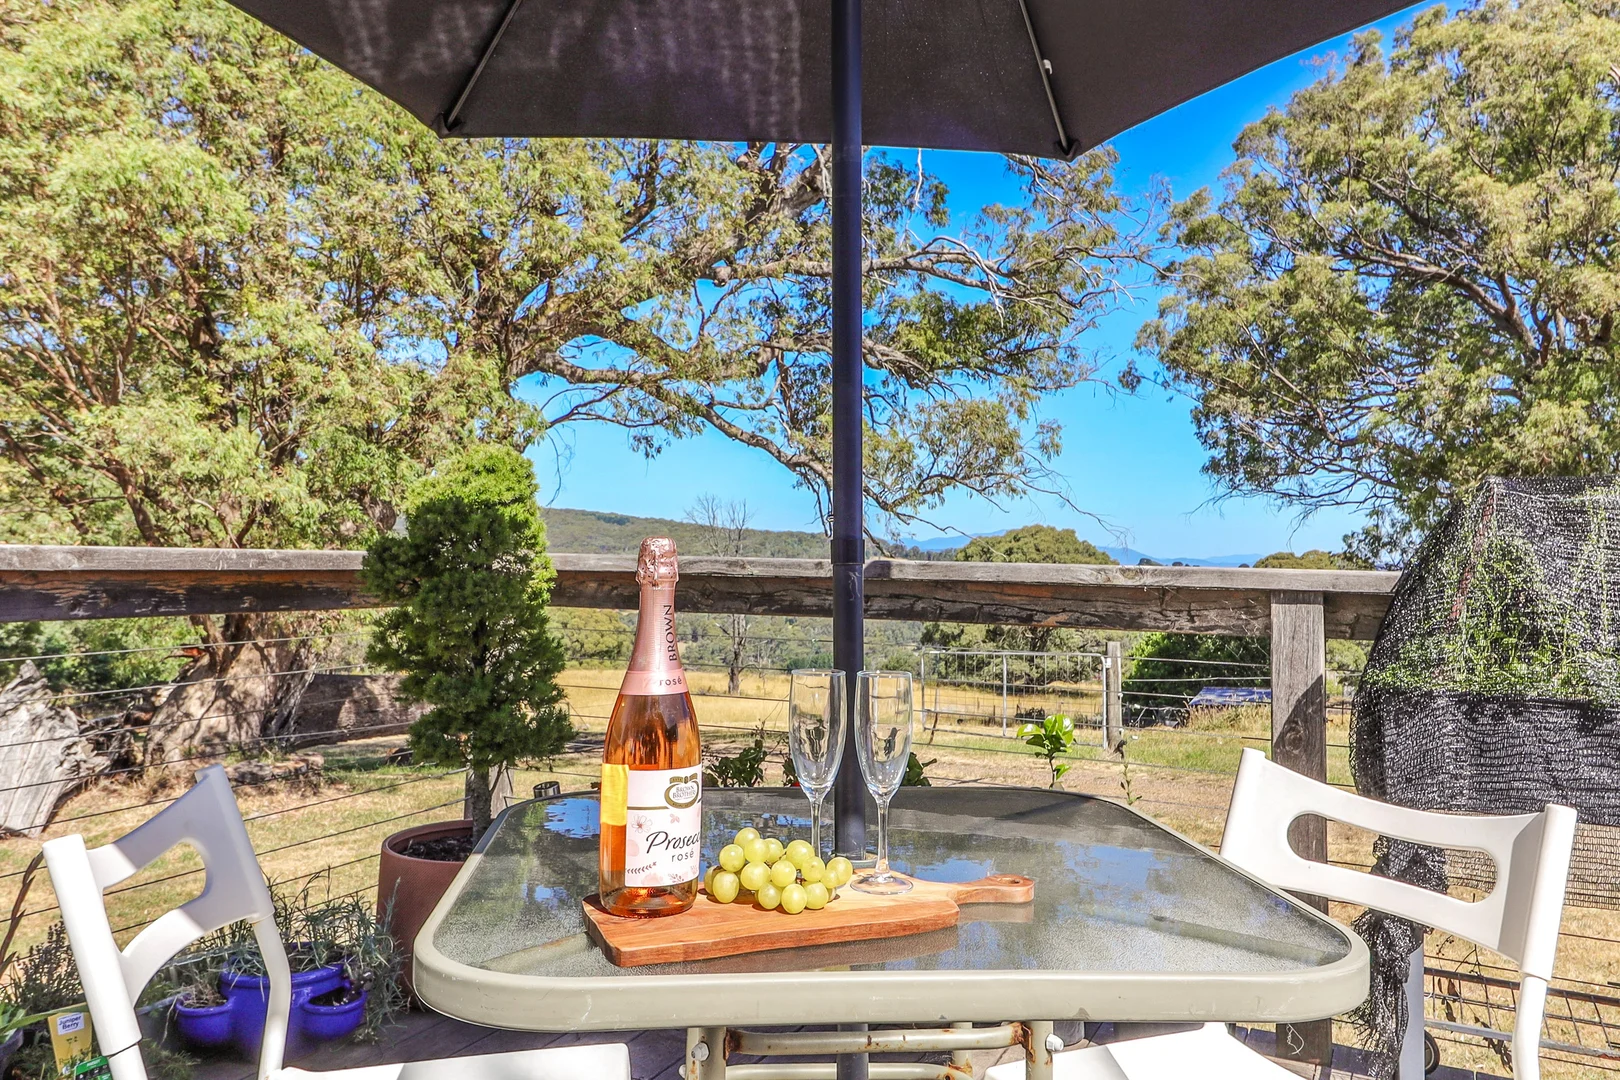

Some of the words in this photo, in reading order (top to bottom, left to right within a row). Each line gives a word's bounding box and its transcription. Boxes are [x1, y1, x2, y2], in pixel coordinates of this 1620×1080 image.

[664, 605, 677, 661] BROWN
[659, 676, 682, 686] rosé
[671, 848, 694, 862] rosé
[59, 1016, 81, 1025] Juniper
